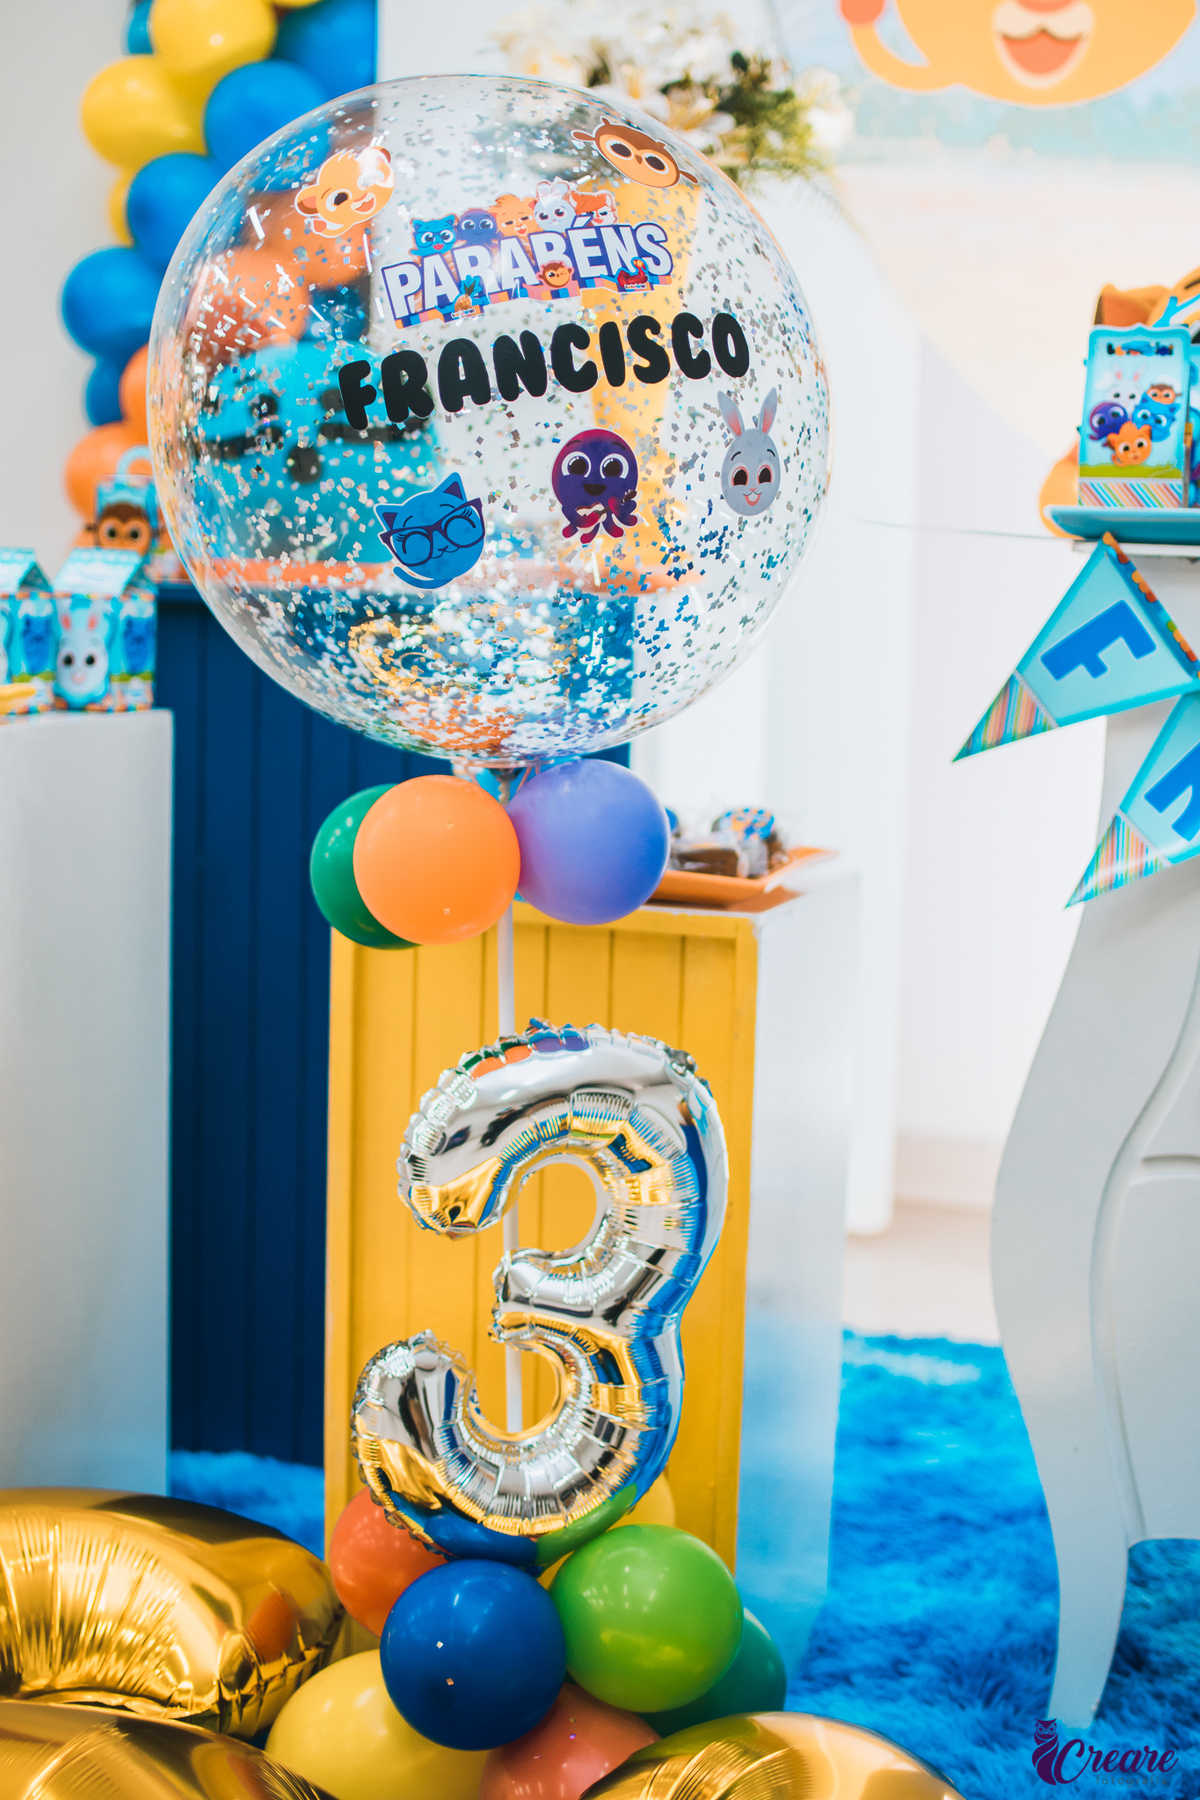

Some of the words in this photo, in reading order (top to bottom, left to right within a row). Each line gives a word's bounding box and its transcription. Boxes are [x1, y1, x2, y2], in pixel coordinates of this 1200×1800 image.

[382, 216, 671, 320] PARABÉNS
[338, 313, 750, 430] FRANCISCO
[1040, 599, 1157, 681] F
[351, 1017, 730, 1566] 3
